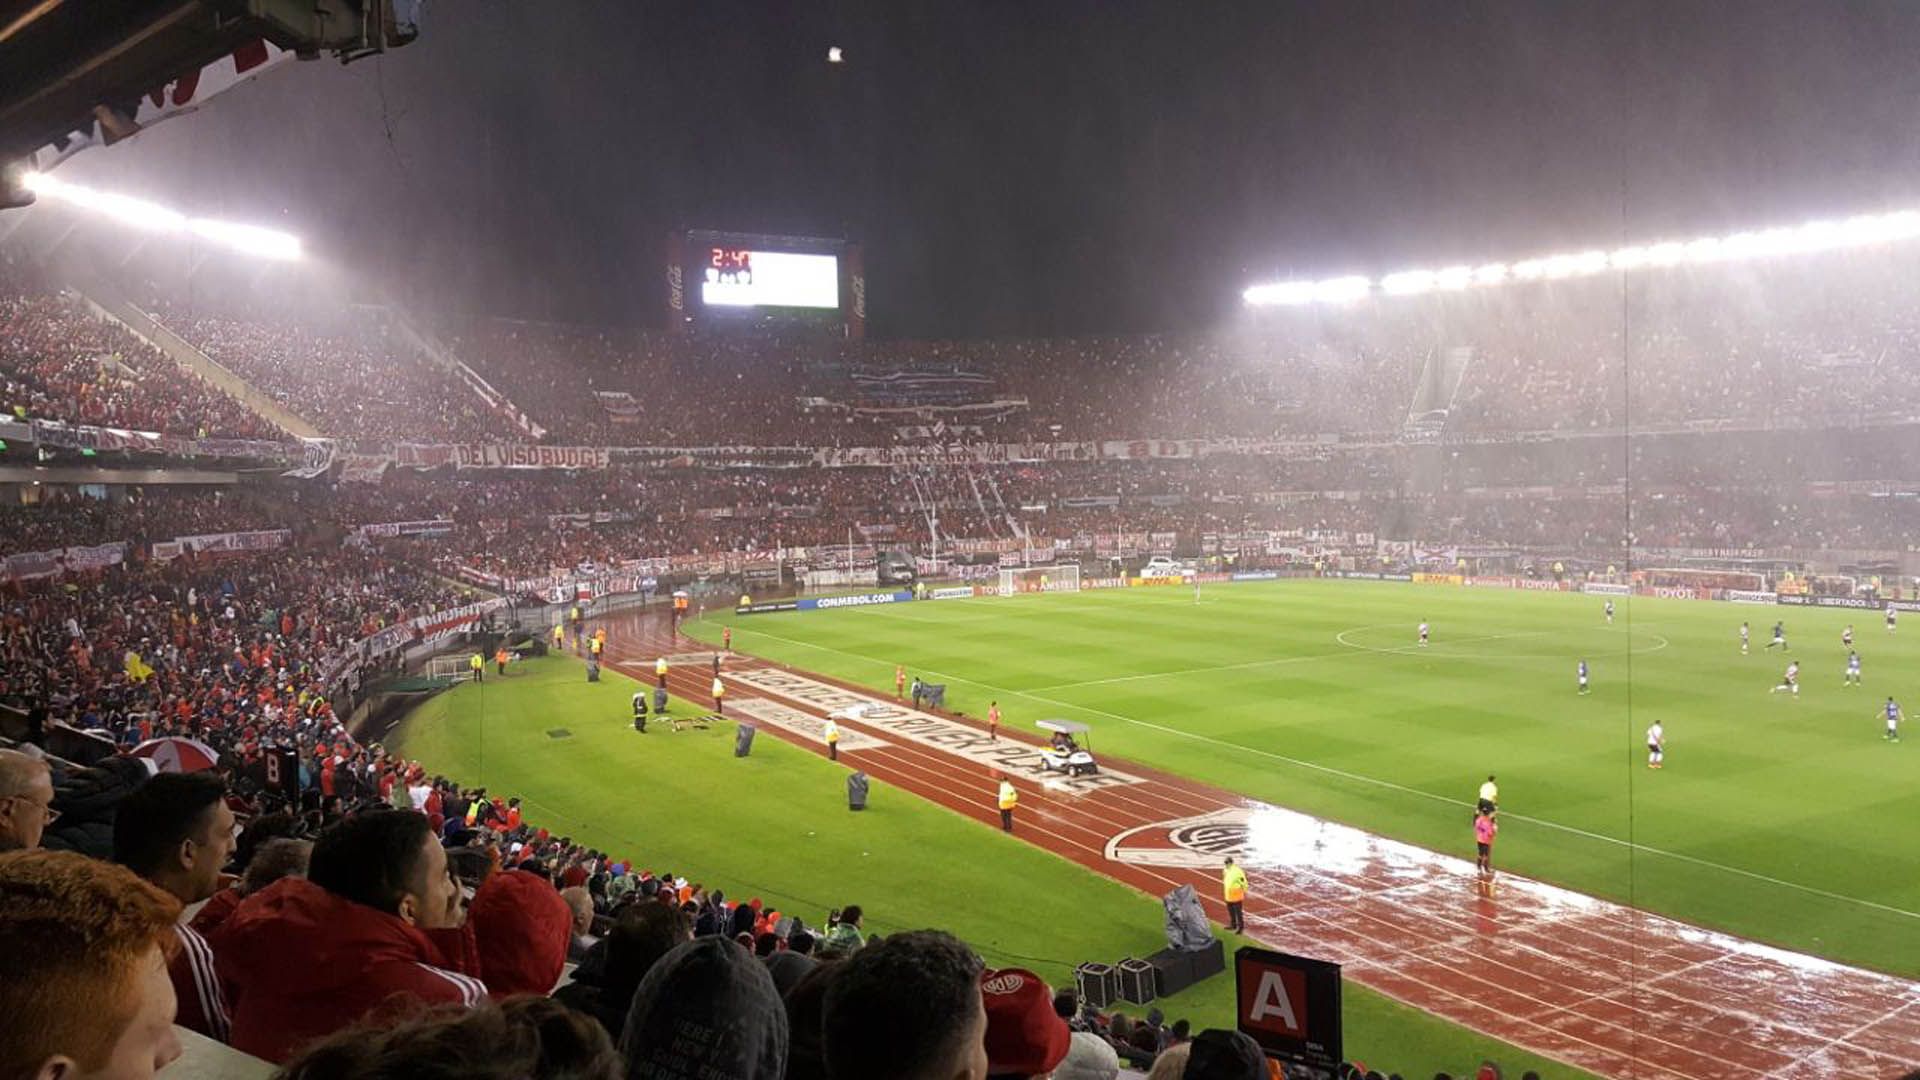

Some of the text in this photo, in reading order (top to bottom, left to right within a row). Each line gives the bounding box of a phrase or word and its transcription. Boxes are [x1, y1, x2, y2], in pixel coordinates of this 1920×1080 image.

[1092, 577, 1129, 588] AMSTEL
[1521, 580, 1560, 590] TOYOTA
[817, 593, 895, 608] CONMEBOL.COM
[1817, 598, 1880, 609] LIBERTADOS
[267, 753, 279, 782] B
[1250, 971, 1297, 1029] A
